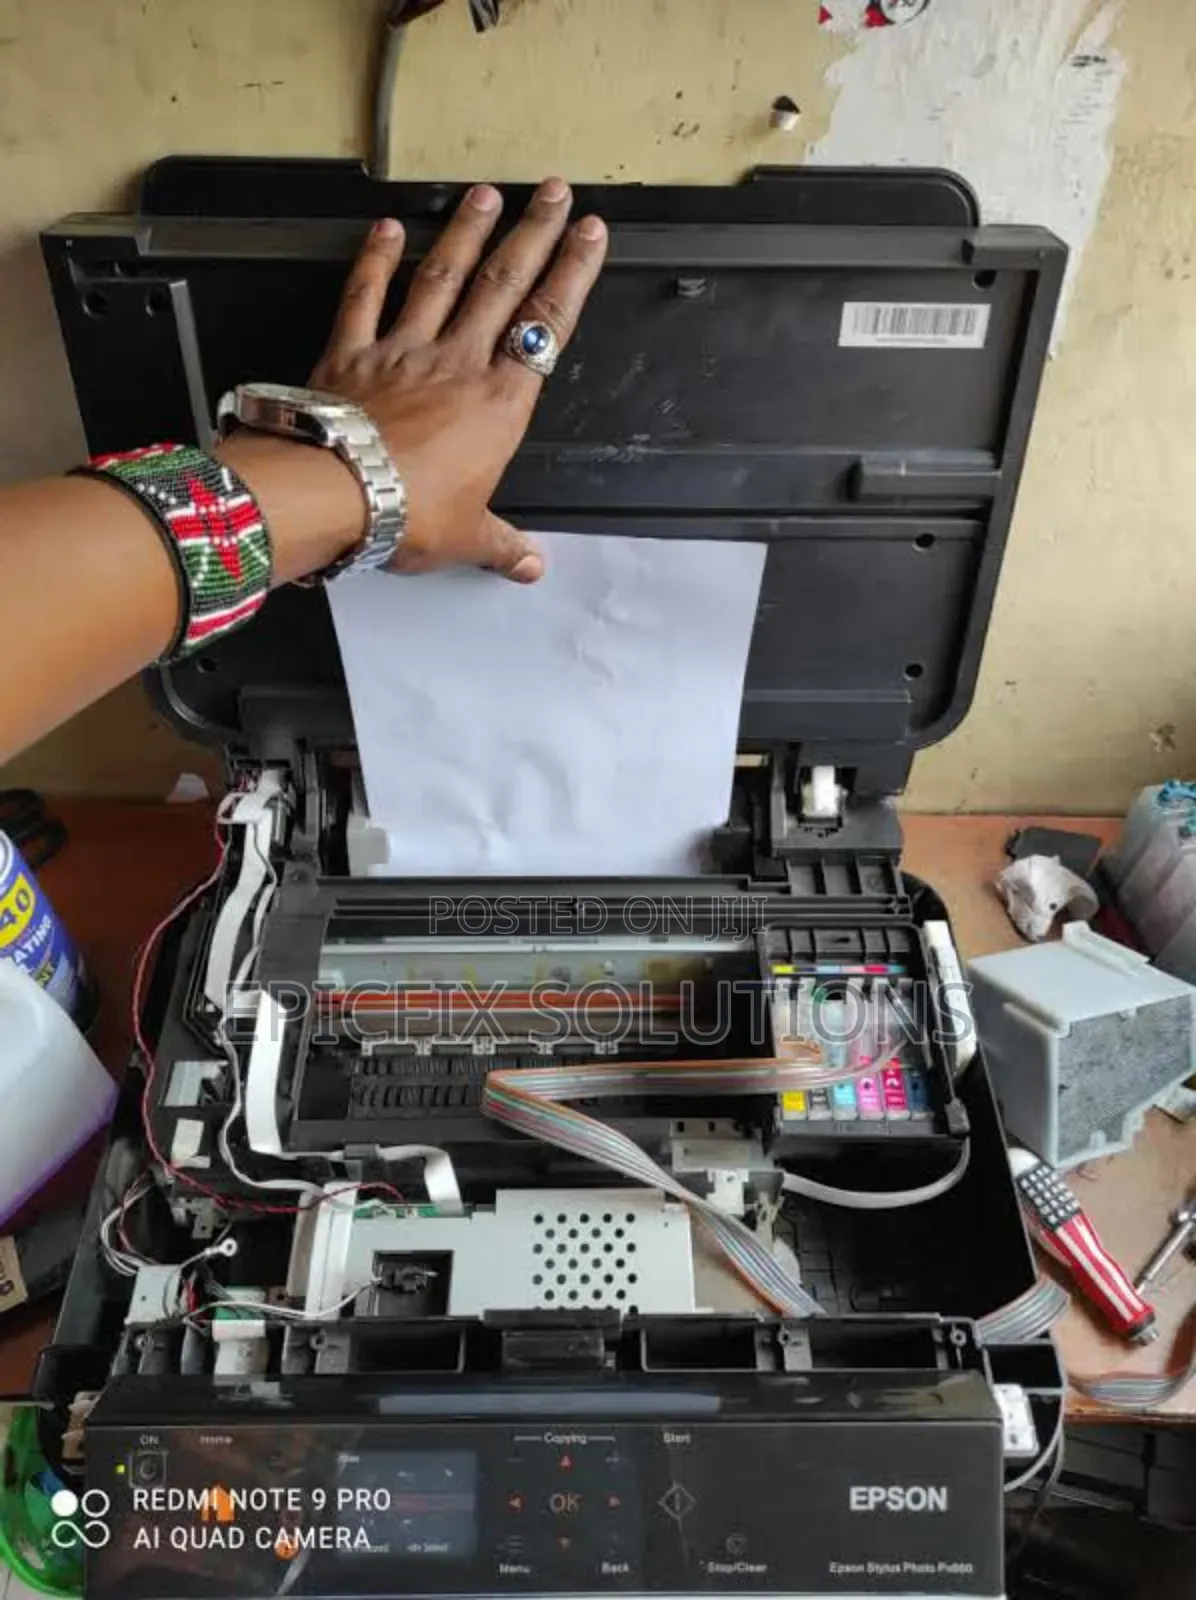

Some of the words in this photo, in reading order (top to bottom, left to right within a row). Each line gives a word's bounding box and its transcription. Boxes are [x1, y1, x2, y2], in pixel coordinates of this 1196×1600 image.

[543, 1432, 588, 1445] Copying
[663, 1432, 692, 1444] Start
[550, 1493, 581, 1513] OK
[849, 1486, 949, 1512] EPSON
[601, 1562, 630, 1573] Back
[829, 1561, 865, 1575] Epson
[867, 1561, 901, 1575] Stylus
[903, 1561, 935, 1574] Photo
